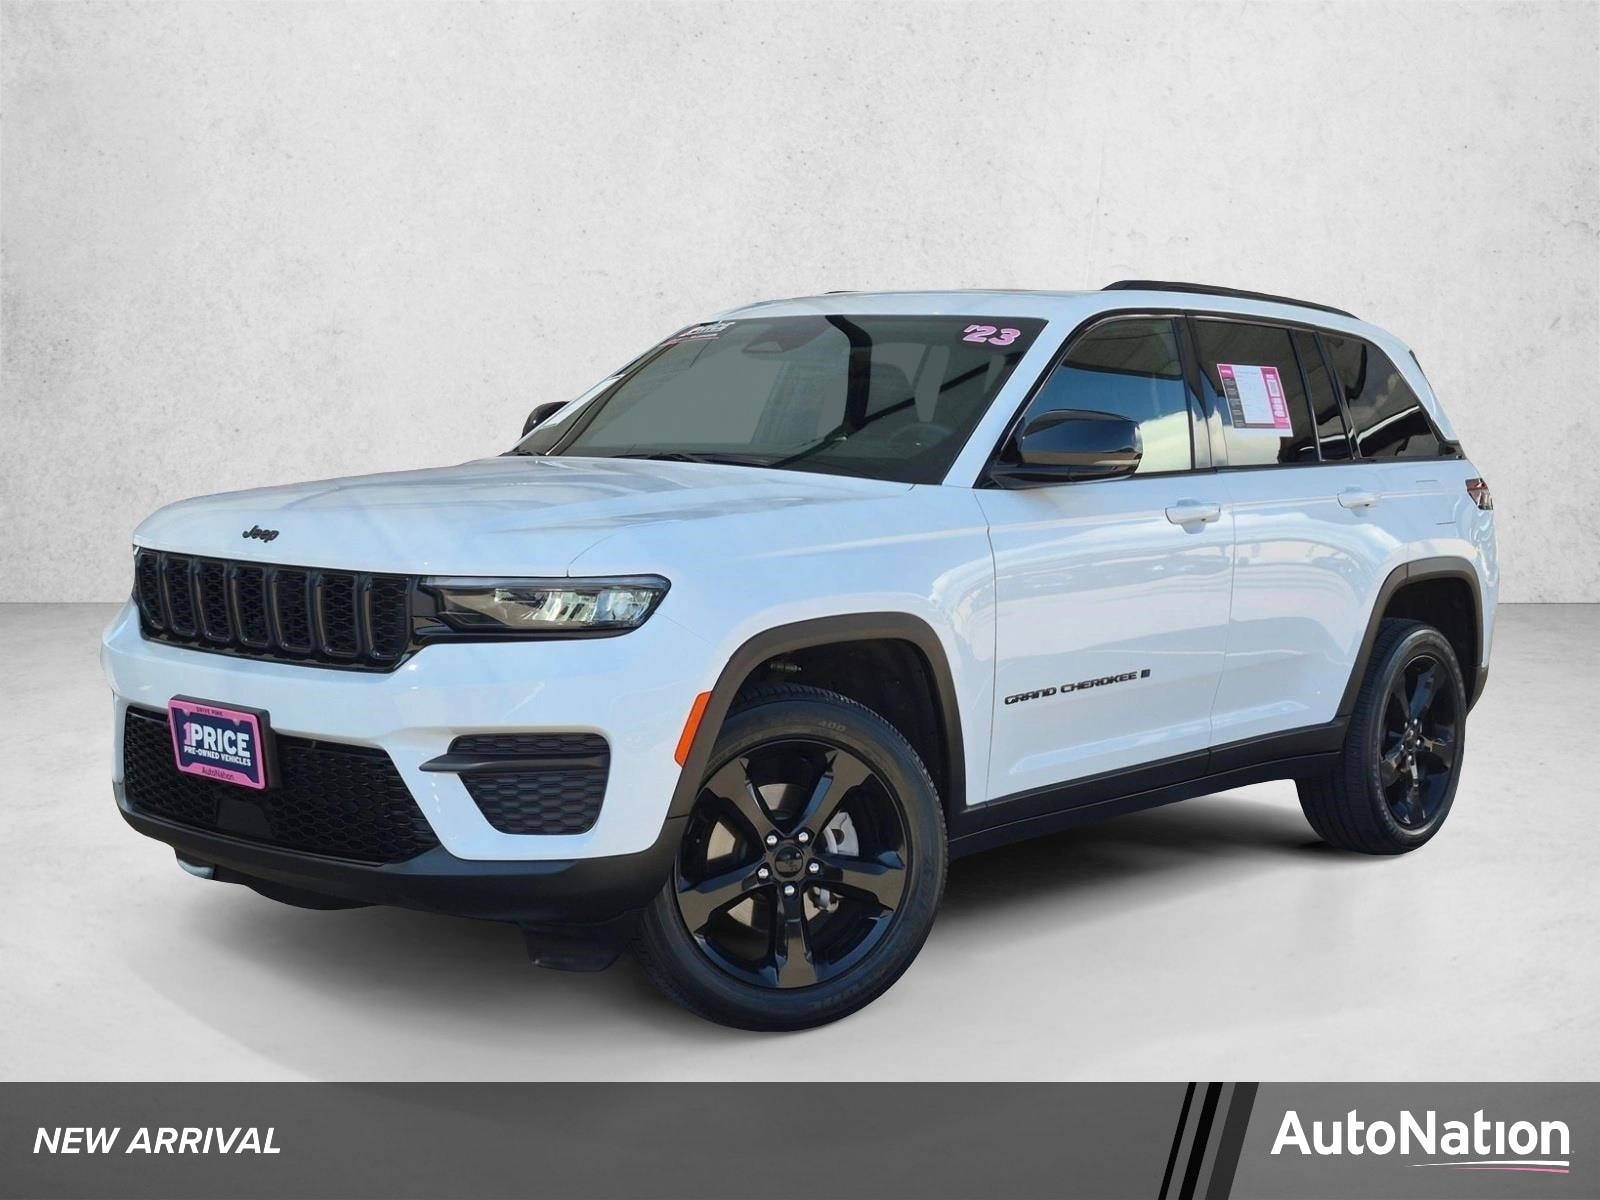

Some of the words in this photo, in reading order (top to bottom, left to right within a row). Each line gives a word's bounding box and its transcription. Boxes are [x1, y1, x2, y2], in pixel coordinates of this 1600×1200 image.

[242, 525, 280, 543] Jeep
[1004, 687, 1056, 705] GRAND
[1060, 671, 1138, 694] CHEROKEE
[183, 745, 220, 760] PRE-OWNED
[221, 753, 251, 767] VEHICLES
[201, 767, 235, 780] AutoNation
